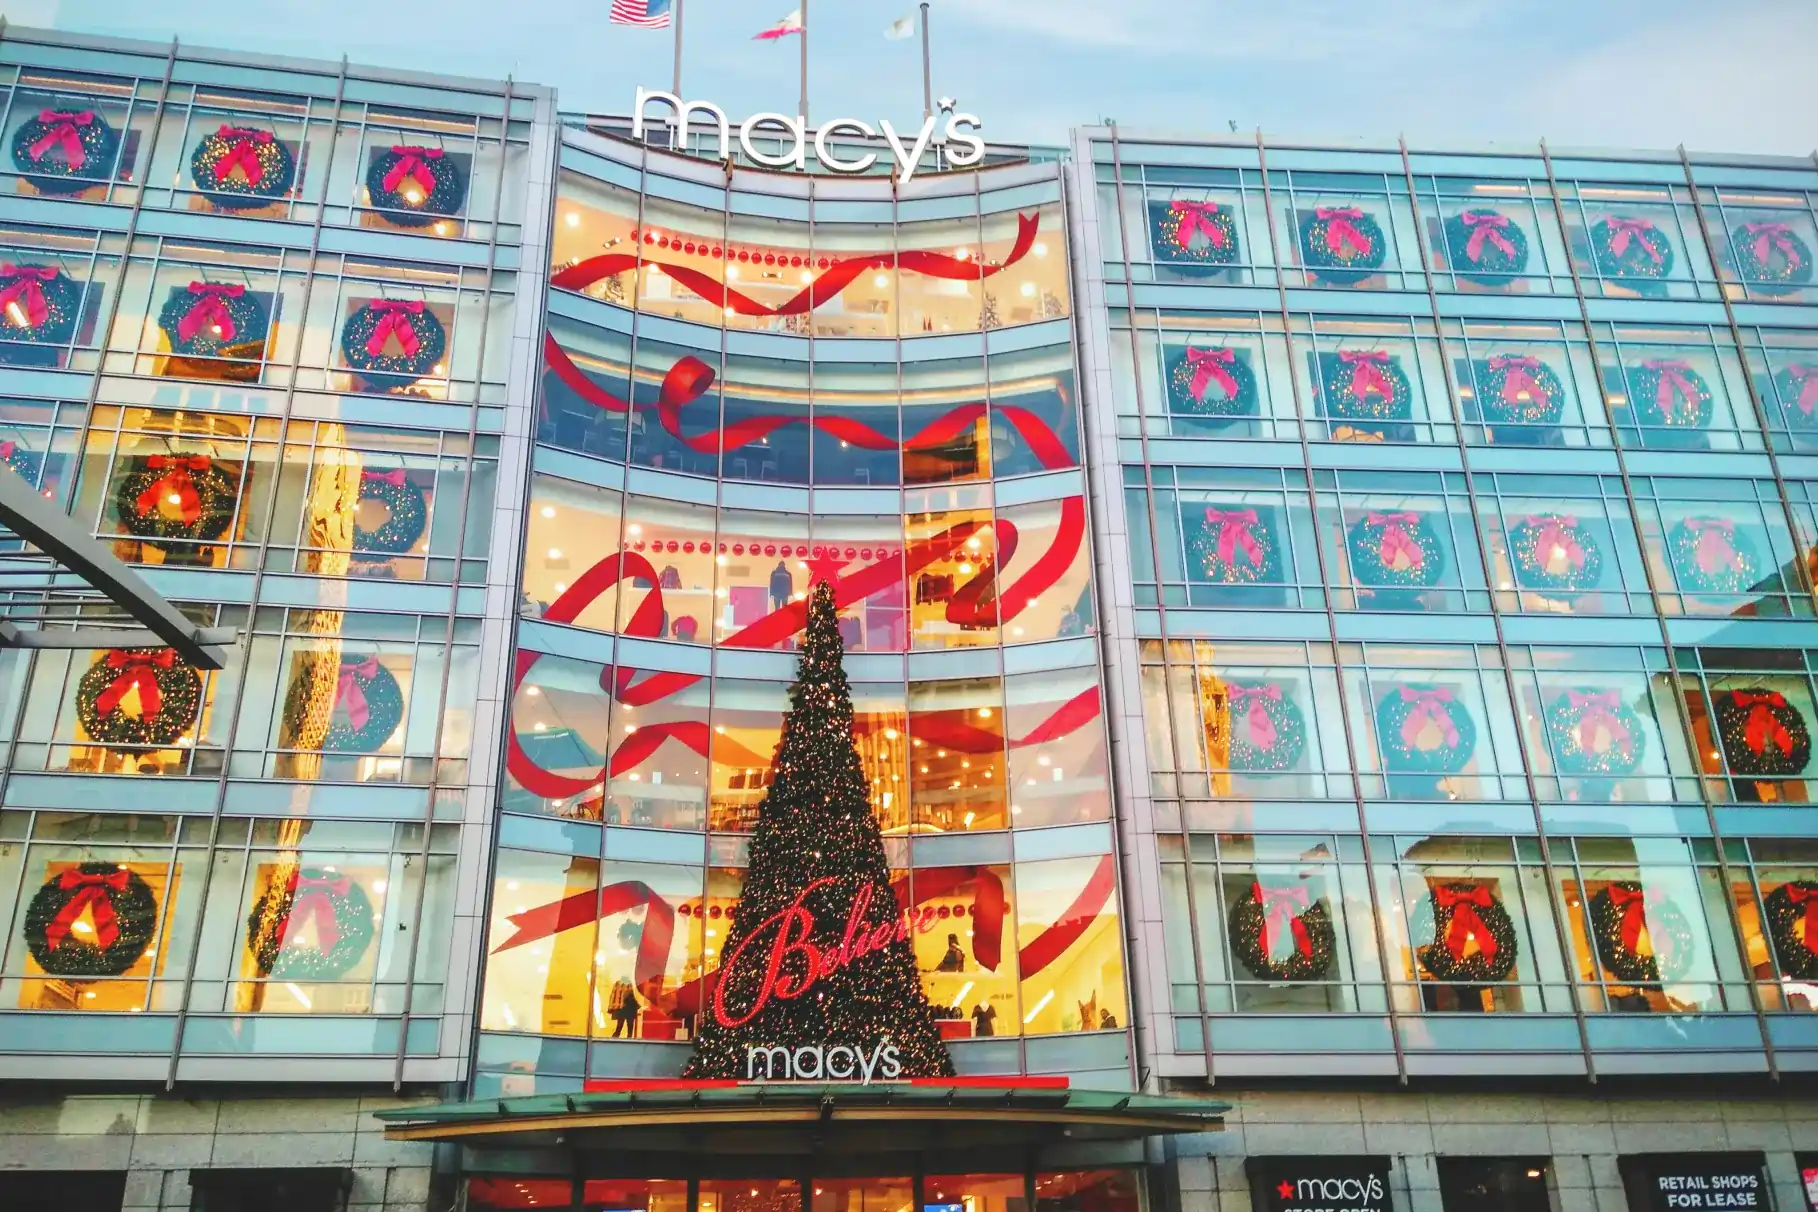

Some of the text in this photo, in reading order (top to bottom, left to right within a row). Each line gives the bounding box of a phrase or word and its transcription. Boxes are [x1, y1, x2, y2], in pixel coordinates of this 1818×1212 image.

[632, 85, 986, 184] macy's
[713, 876, 941, 1028] Believe
[1659, 1175, 1758, 1190] RETAIL SHOPS
[1667, 1193, 1757, 1207] FOR LEASE
